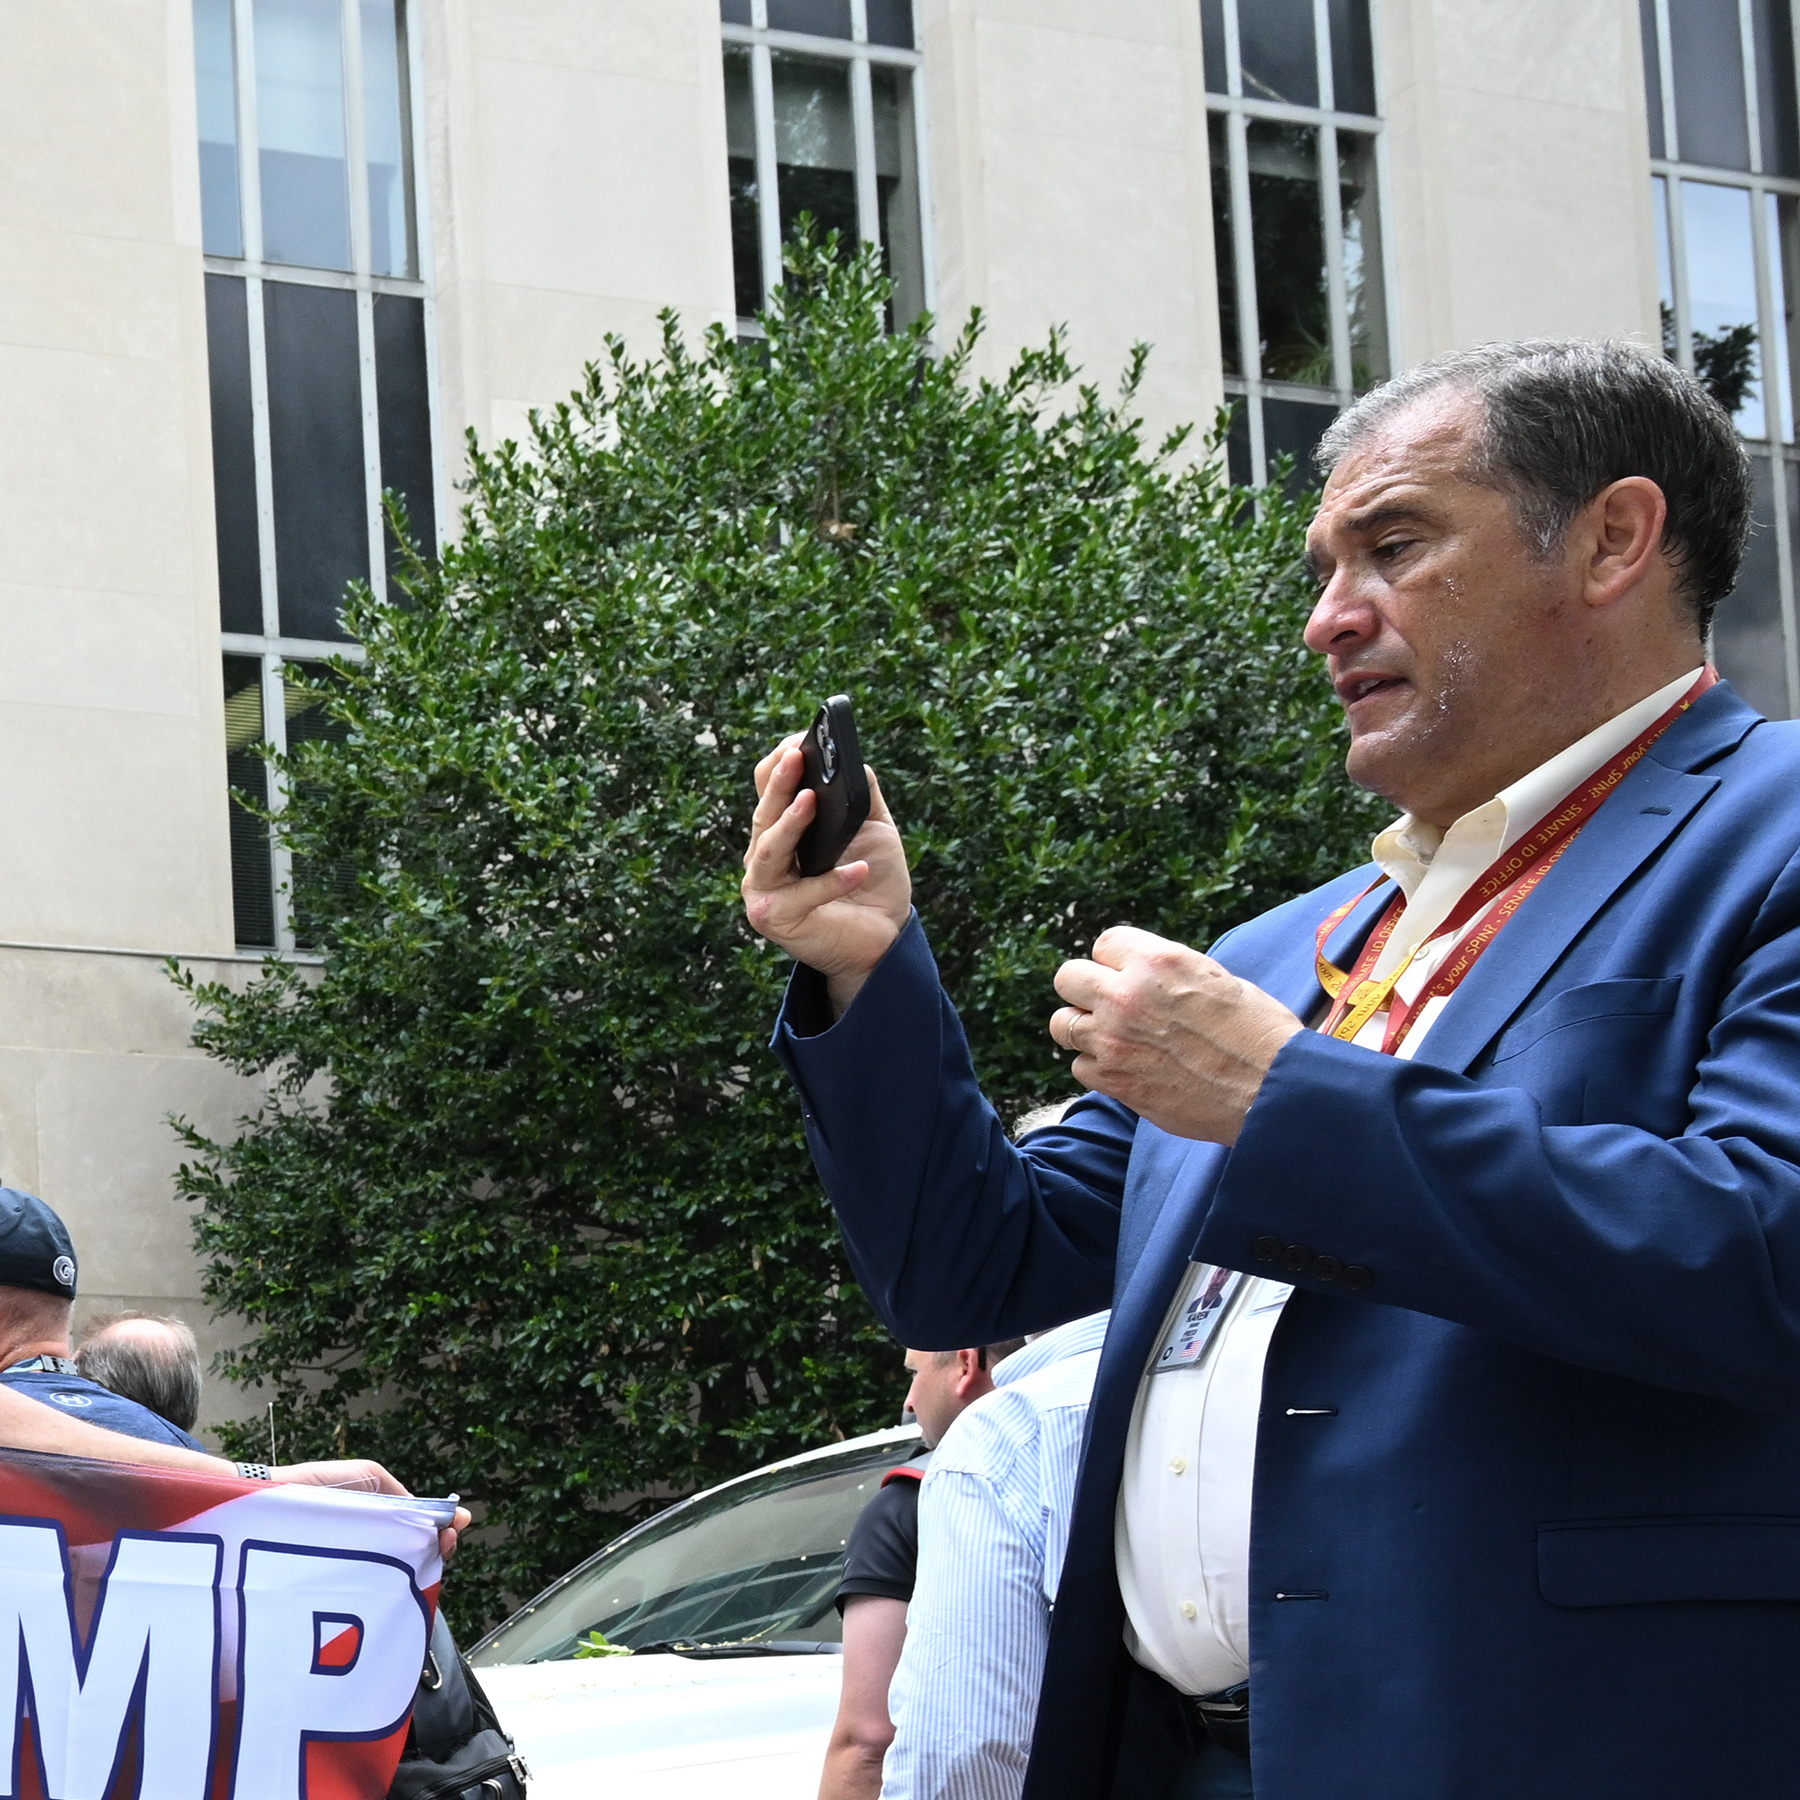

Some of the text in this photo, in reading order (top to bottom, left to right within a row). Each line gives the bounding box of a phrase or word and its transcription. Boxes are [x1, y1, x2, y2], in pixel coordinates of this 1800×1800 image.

[1622, 745, 1648, 771] your
[1589, 768, 1624, 800] SPIN?
[1536, 804, 1583, 845] SENATE
[1521, 843, 1538, 858] ID
[1479, 857, 1524, 898] OFFICE
[1444, 955, 1469, 986] your
[1465, 923, 1499, 957] SPIN?
[1499, 877, 1540, 917] SENATE
[1536, 864, 1552, 878] ID
[1371, 940, 1385, 957] ID
